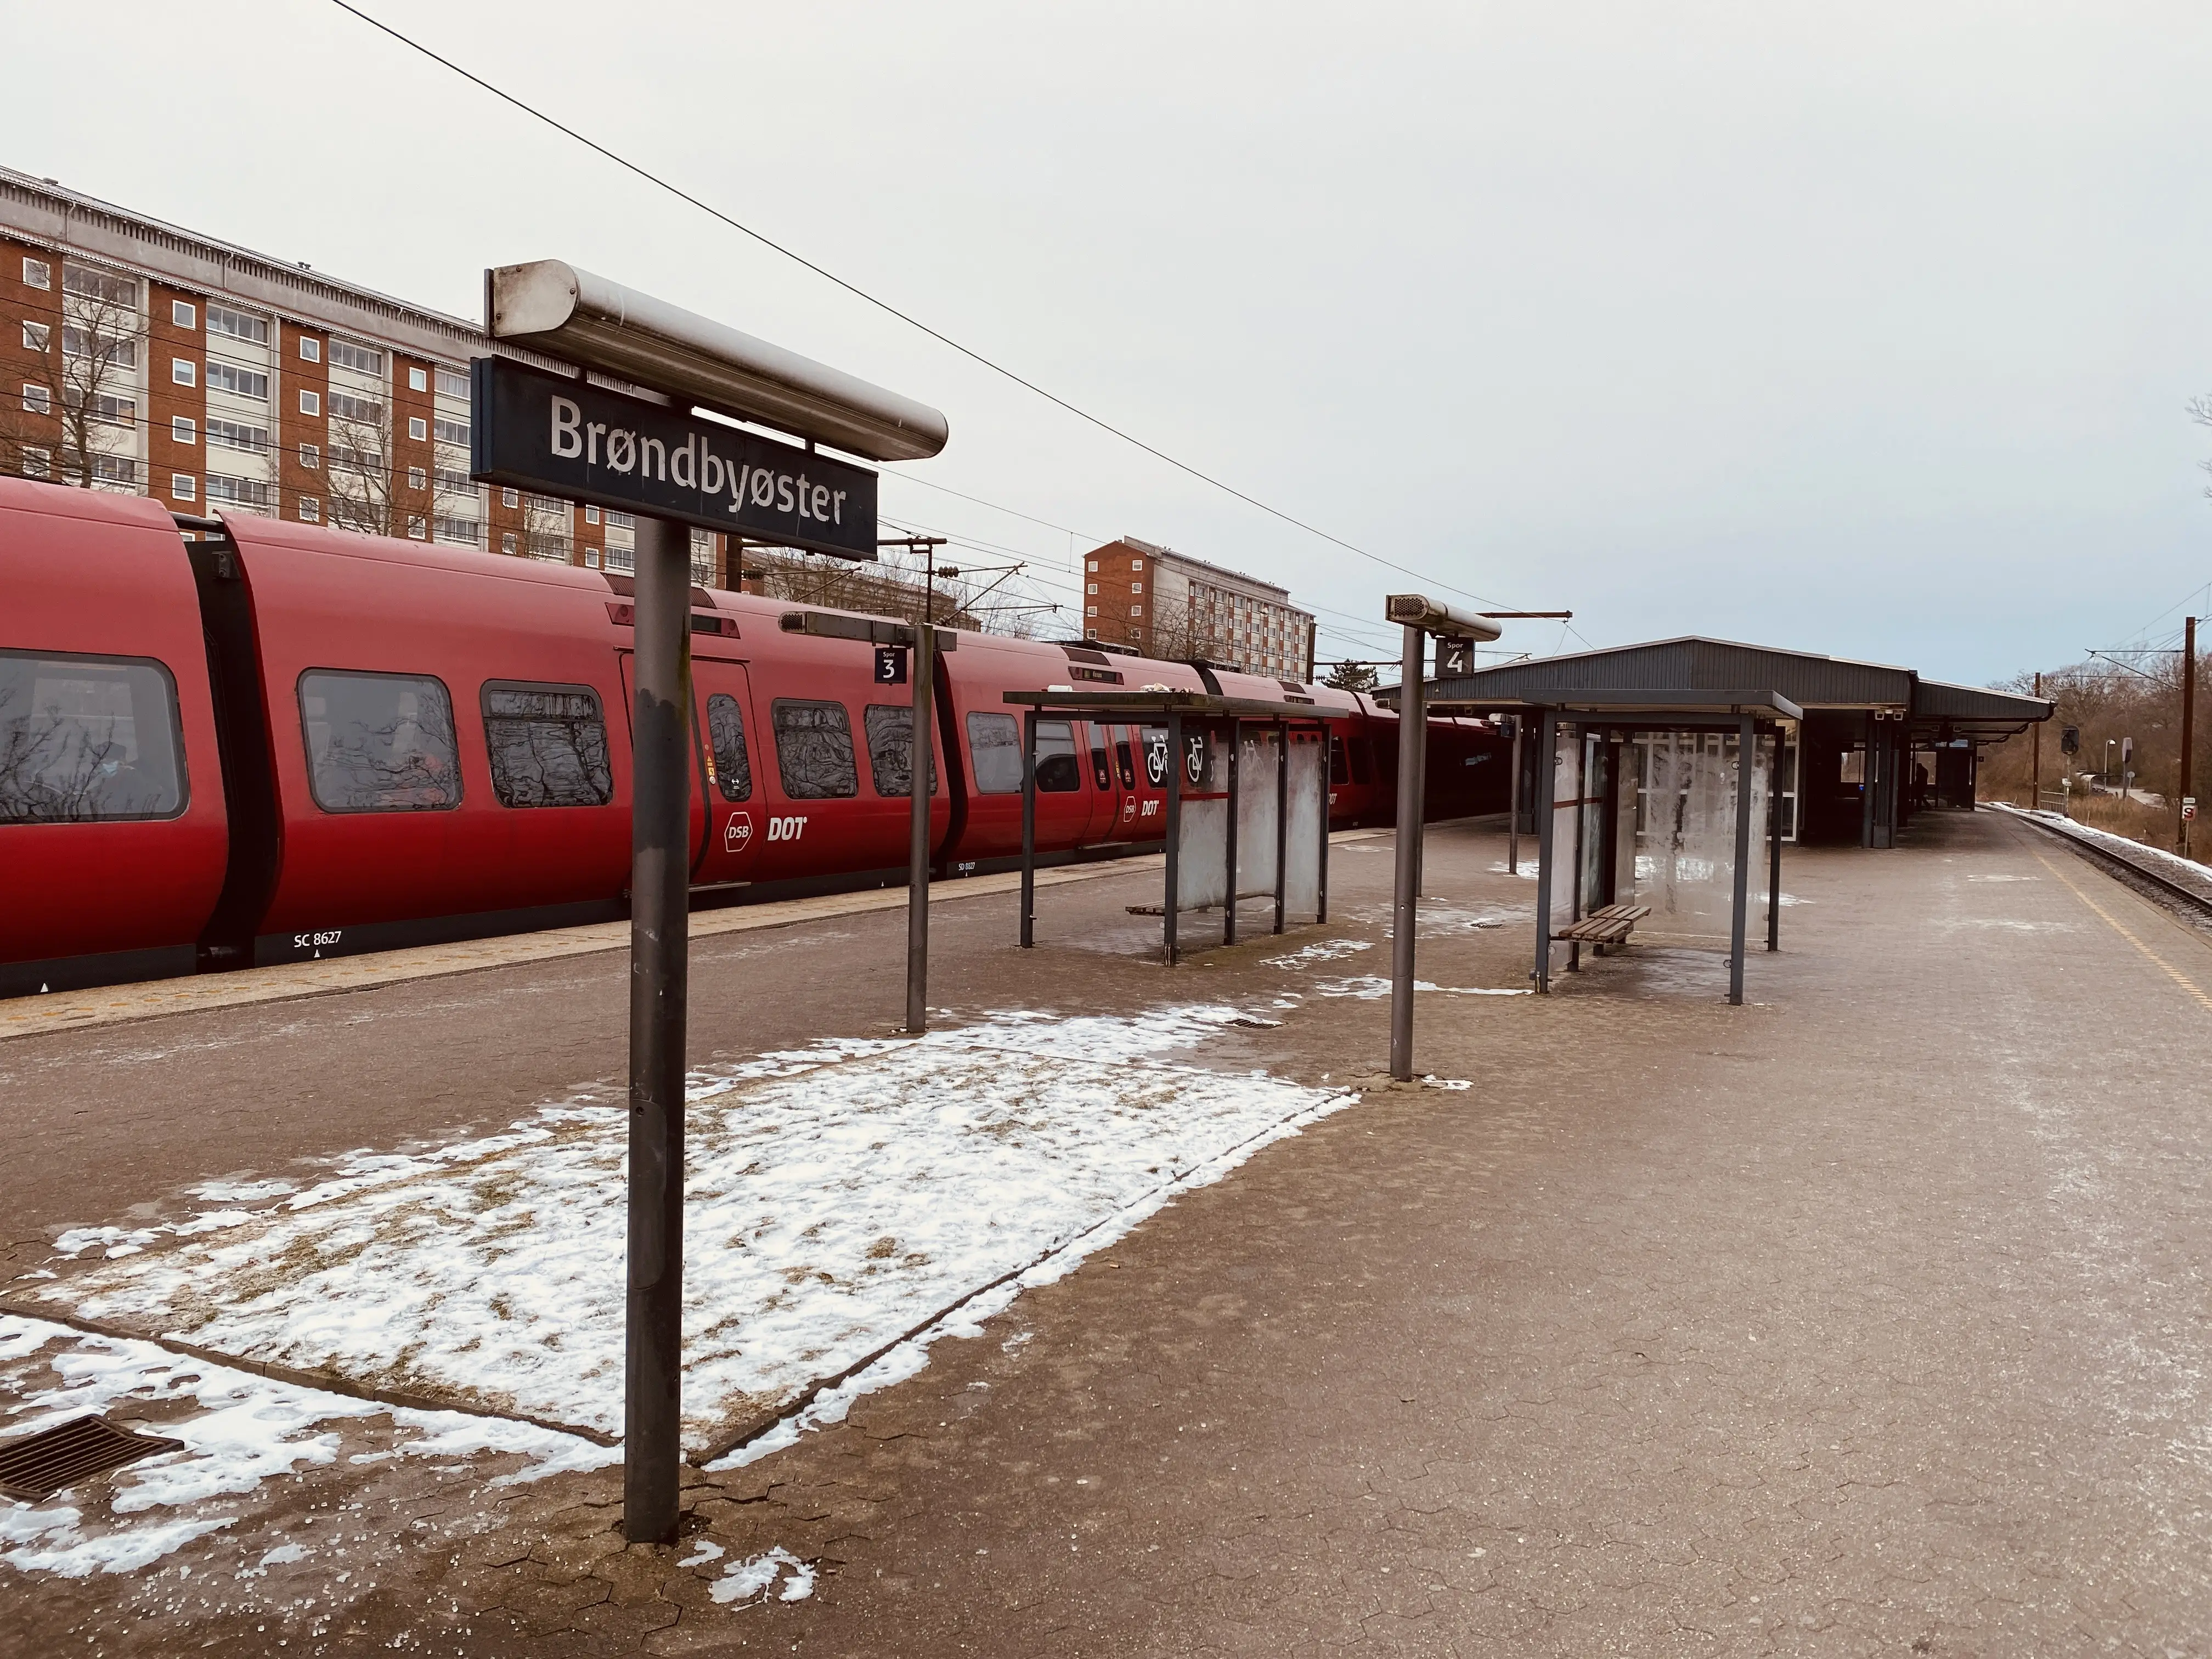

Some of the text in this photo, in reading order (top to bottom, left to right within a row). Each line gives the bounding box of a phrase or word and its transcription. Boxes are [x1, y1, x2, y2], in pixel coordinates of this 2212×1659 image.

[551, 395, 847, 525] Brøndbyøster
[883, 659, 895, 678] 3
[1447, 651, 1463, 673] 4
[1125, 805, 1135, 814] DSB
[1141, 800, 1159, 816] DOT
[729, 826, 749, 839] DSB
[768, 816, 807, 840] DOT
[294, 930, 342, 947] SC 8627
